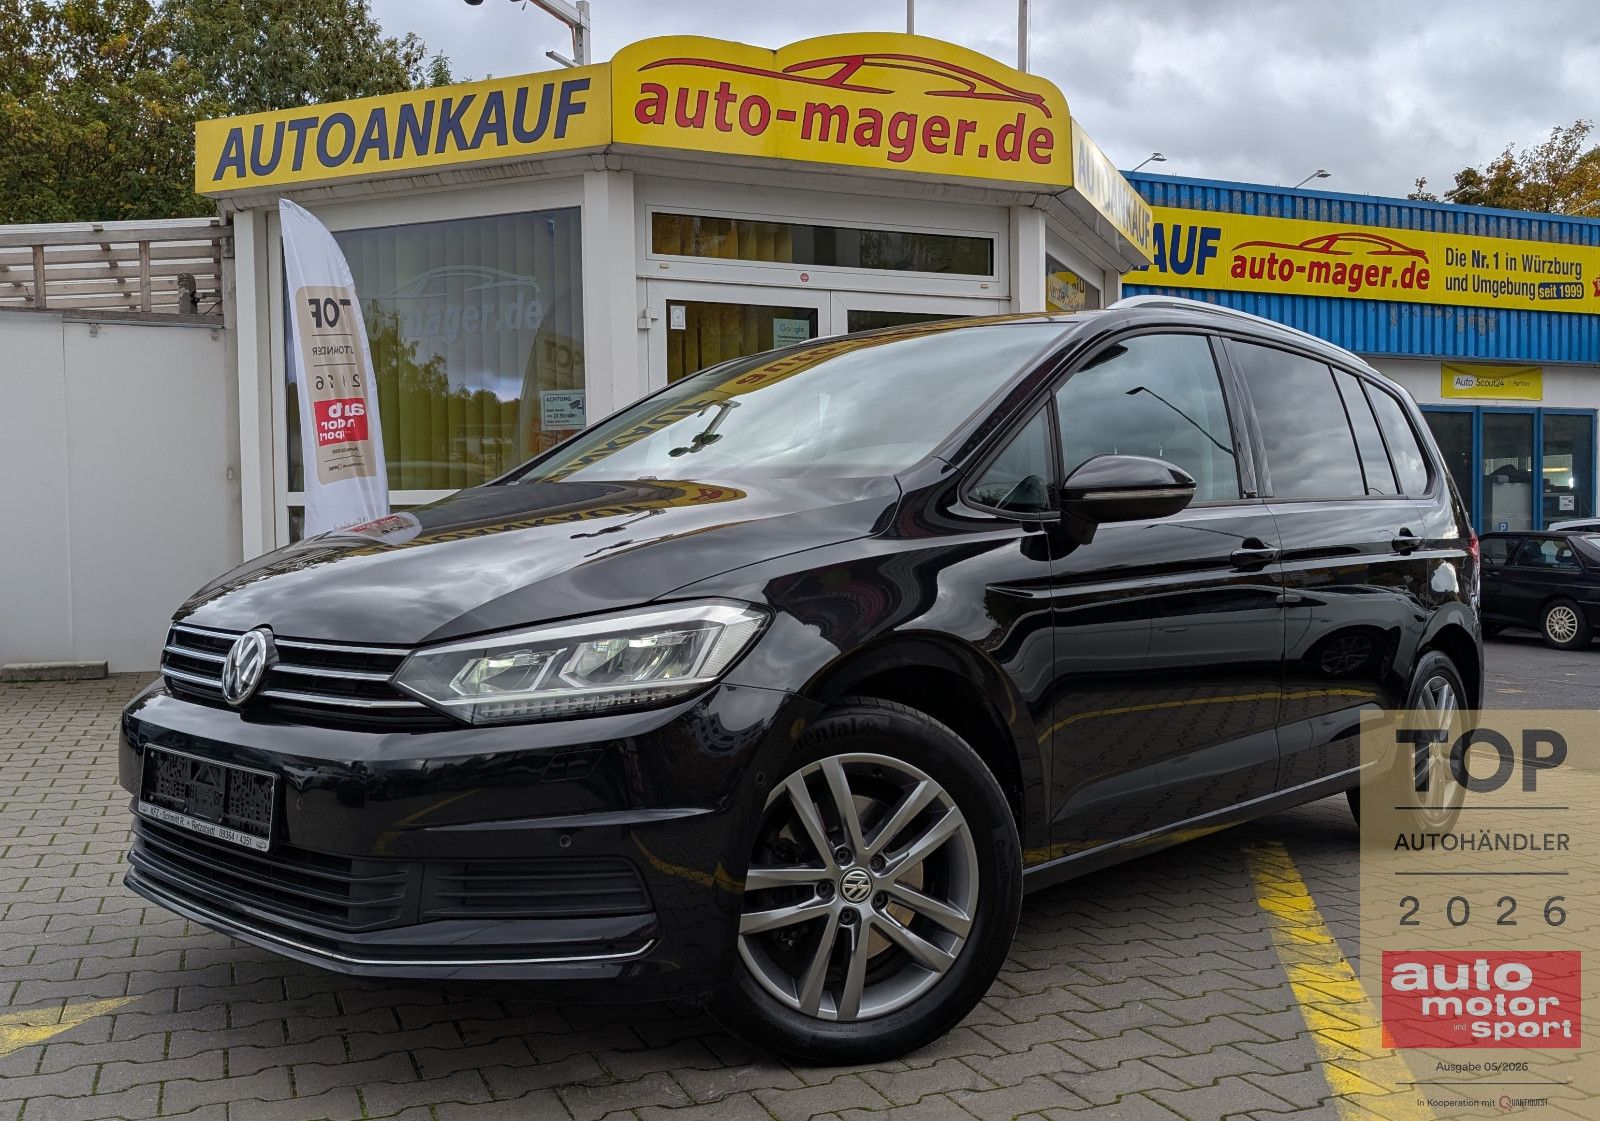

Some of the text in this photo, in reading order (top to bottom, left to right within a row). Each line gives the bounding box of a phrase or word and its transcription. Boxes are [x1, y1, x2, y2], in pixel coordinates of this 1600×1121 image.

[212, 78, 591, 181] AUTOANKAUF
[634, 81, 1055, 165] auto-mager.de
[1134, 223, 1221, 275] AUF
[1445, 247, 1582, 280] Die Nr. 1 in Würzburg
[1230, 252, 1431, 293] auto-mager.de
[1445, 274, 1583, 300] und Umgebung seit 1999
[1455, 377, 1474, 388] Auto
[1475, 378, 1505, 388] Scout24
